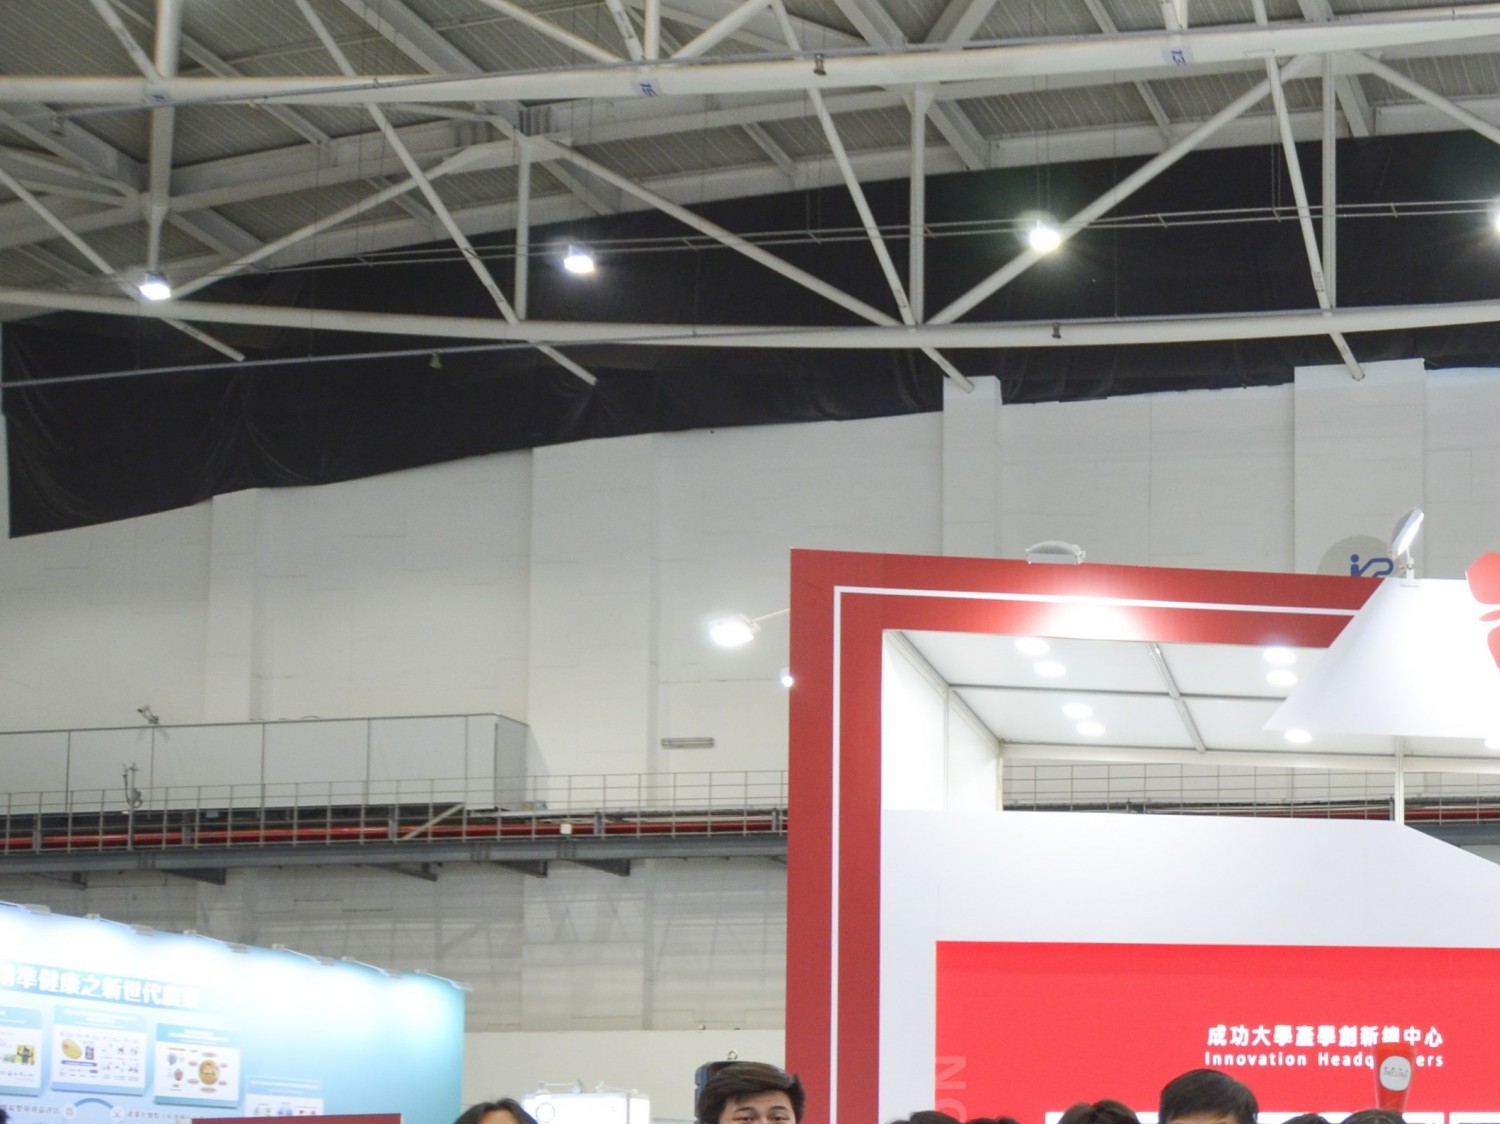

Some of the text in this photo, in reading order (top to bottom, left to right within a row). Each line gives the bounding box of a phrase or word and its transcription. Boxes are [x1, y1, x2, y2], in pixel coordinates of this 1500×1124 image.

[1207, 1024, 1444, 1048] 成功大學產學創新總中心
[1205, 1052, 1444, 1069] Innovation Headqers
